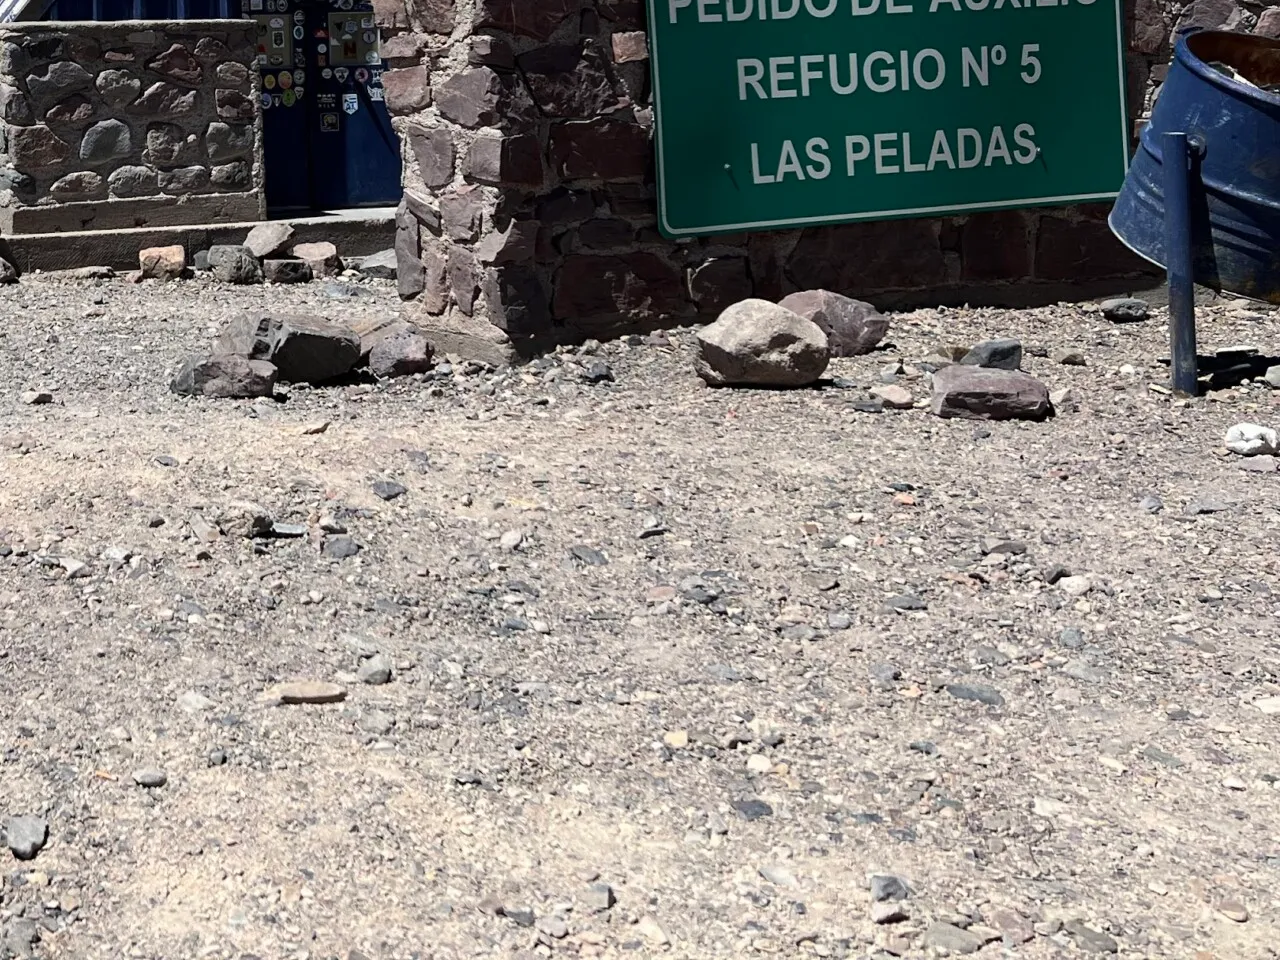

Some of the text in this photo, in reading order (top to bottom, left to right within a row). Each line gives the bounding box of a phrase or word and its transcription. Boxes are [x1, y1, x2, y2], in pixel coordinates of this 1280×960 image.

[737, 43, 1042, 101] REFUGIO Nº 5
[750, 123, 1038, 185] LAS PELADAS
